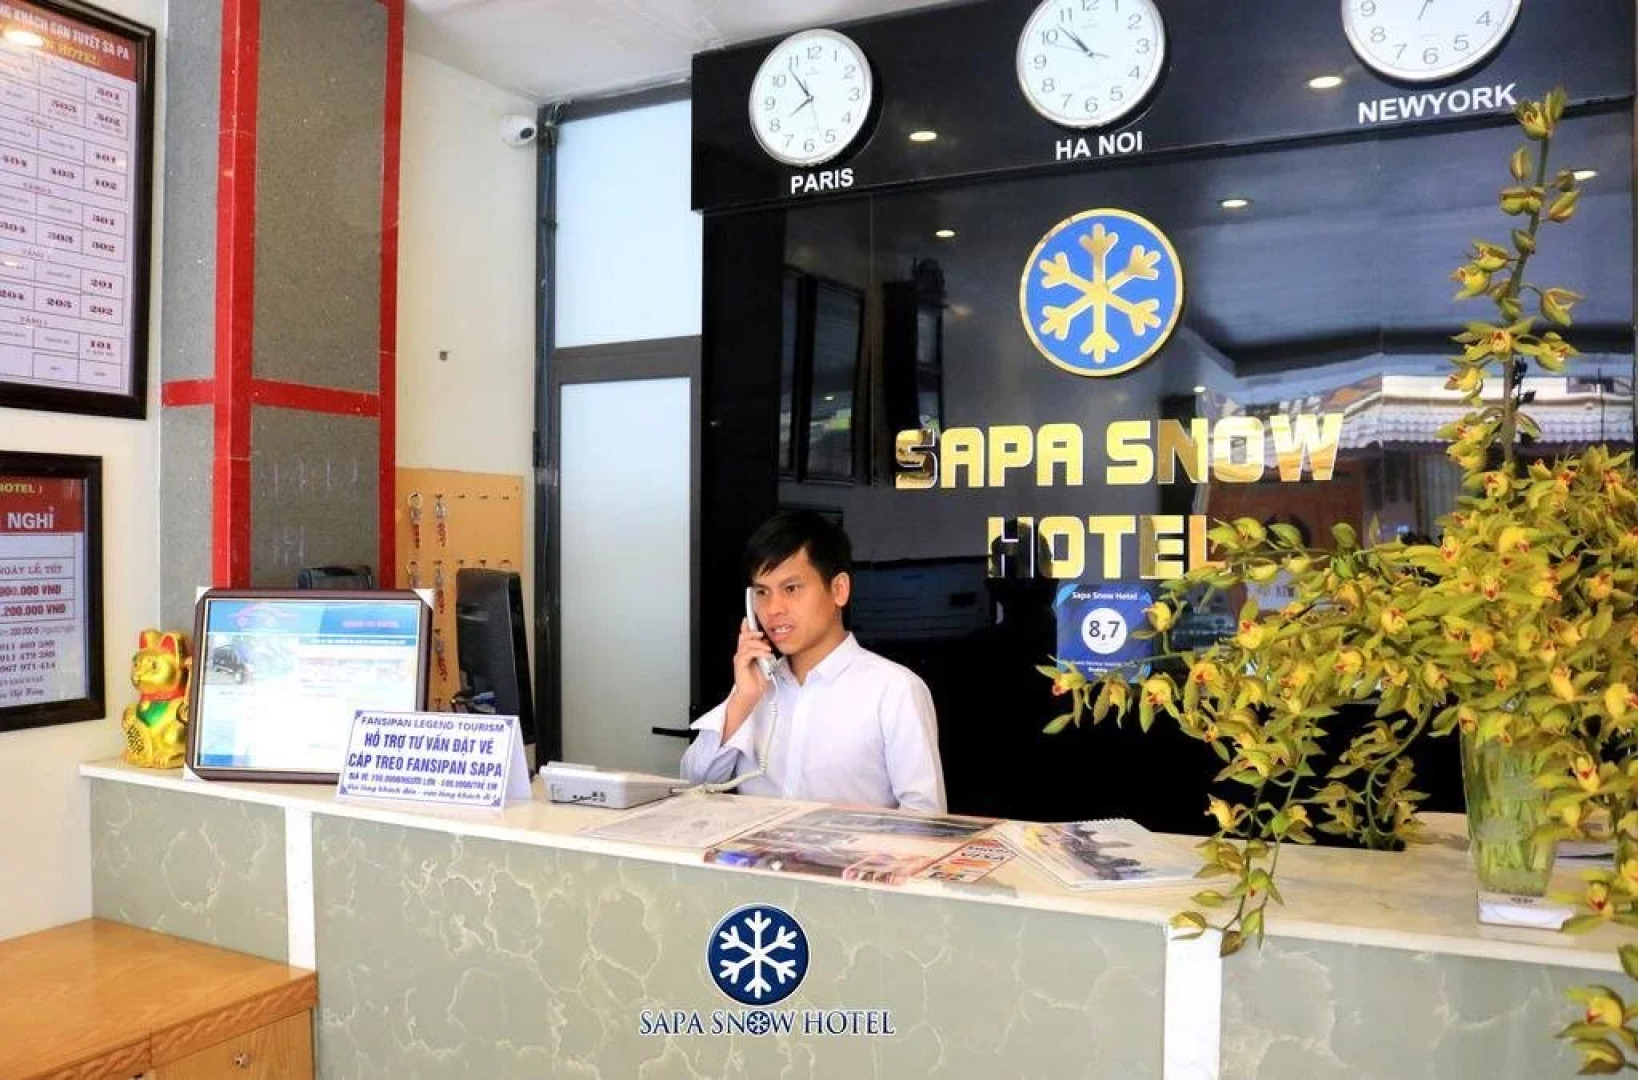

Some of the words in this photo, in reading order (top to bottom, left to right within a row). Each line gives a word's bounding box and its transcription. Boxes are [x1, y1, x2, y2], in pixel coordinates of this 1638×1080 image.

[1060, 8, 1072, 22] 11
[1128, 13, 1141, 29] 2
[1476, 10, 1491, 27] 4
[1042, 29, 1058, 45] 10
[1370, 26, 1385, 43] 8
[102, 40, 115, 56] SA
[116, 44, 129, 60] PA
[1136, 38, 1150, 53] 3
[1453, 34, 1469, 51] 5
[807, 46, 822, 60] 12
[834, 50, 838, 62] 1
[1394, 43, 1407, 60] 7
[1422, 47, 1439, 64] 6
[789, 55, 799, 68] 11
[1034, 54, 1046, 69] 9
[844, 64, 856, 79] 2
[1128, 66, 1140, 79] 4
[772, 74, 787, 87] 10
[1042, 78, 1054, 92] 8
[849, 87, 860, 102] 3
[1061, 93, 1072, 109] 7
[1111, 86, 1123, 101] 5
[765, 95, 776, 111] 9
[1085, 97, 1098, 112] 6
[1358, 82, 1517, 123] NEWYORK
[841, 111, 851, 123] 4
[770, 118, 780, 132] 8
[784, 134, 794, 147] 7
[824, 129, 835, 143] 5
[804, 139, 814, 152] 6
[1055, 138, 1091, 160] HA
[1098, 130, 1143, 156] NOI
[790, 167, 854, 195] PARIS
[90, 340, 111, 350] 101
[895, 423, 1085, 489] SAPA
[1106, 413, 1344, 485] SNOW
[7, 505, 54, 529] NGHỈ
[987, 514, 1222, 580] HOTEL
[1072, 592, 1091, 601] Sapa
[1092, 592, 1114, 600] Snow
[1115, 592, 1138, 600] Hotel
[1088, 620, 1120, 641] 8,7
[361, 716, 412, 727] FANSIPAN
[414, 719, 454, 730] LEGEND
[458, 722, 505, 732] TOURISM
[384, 733, 406, 752] TRỢ
[409, 735, 425, 750] TƯ
[348, 751, 372, 767] CÁP
[375, 755, 404, 770] TREO
[406, 758, 467, 775] FANSIPAN
[470, 761, 502, 777] SAPA
